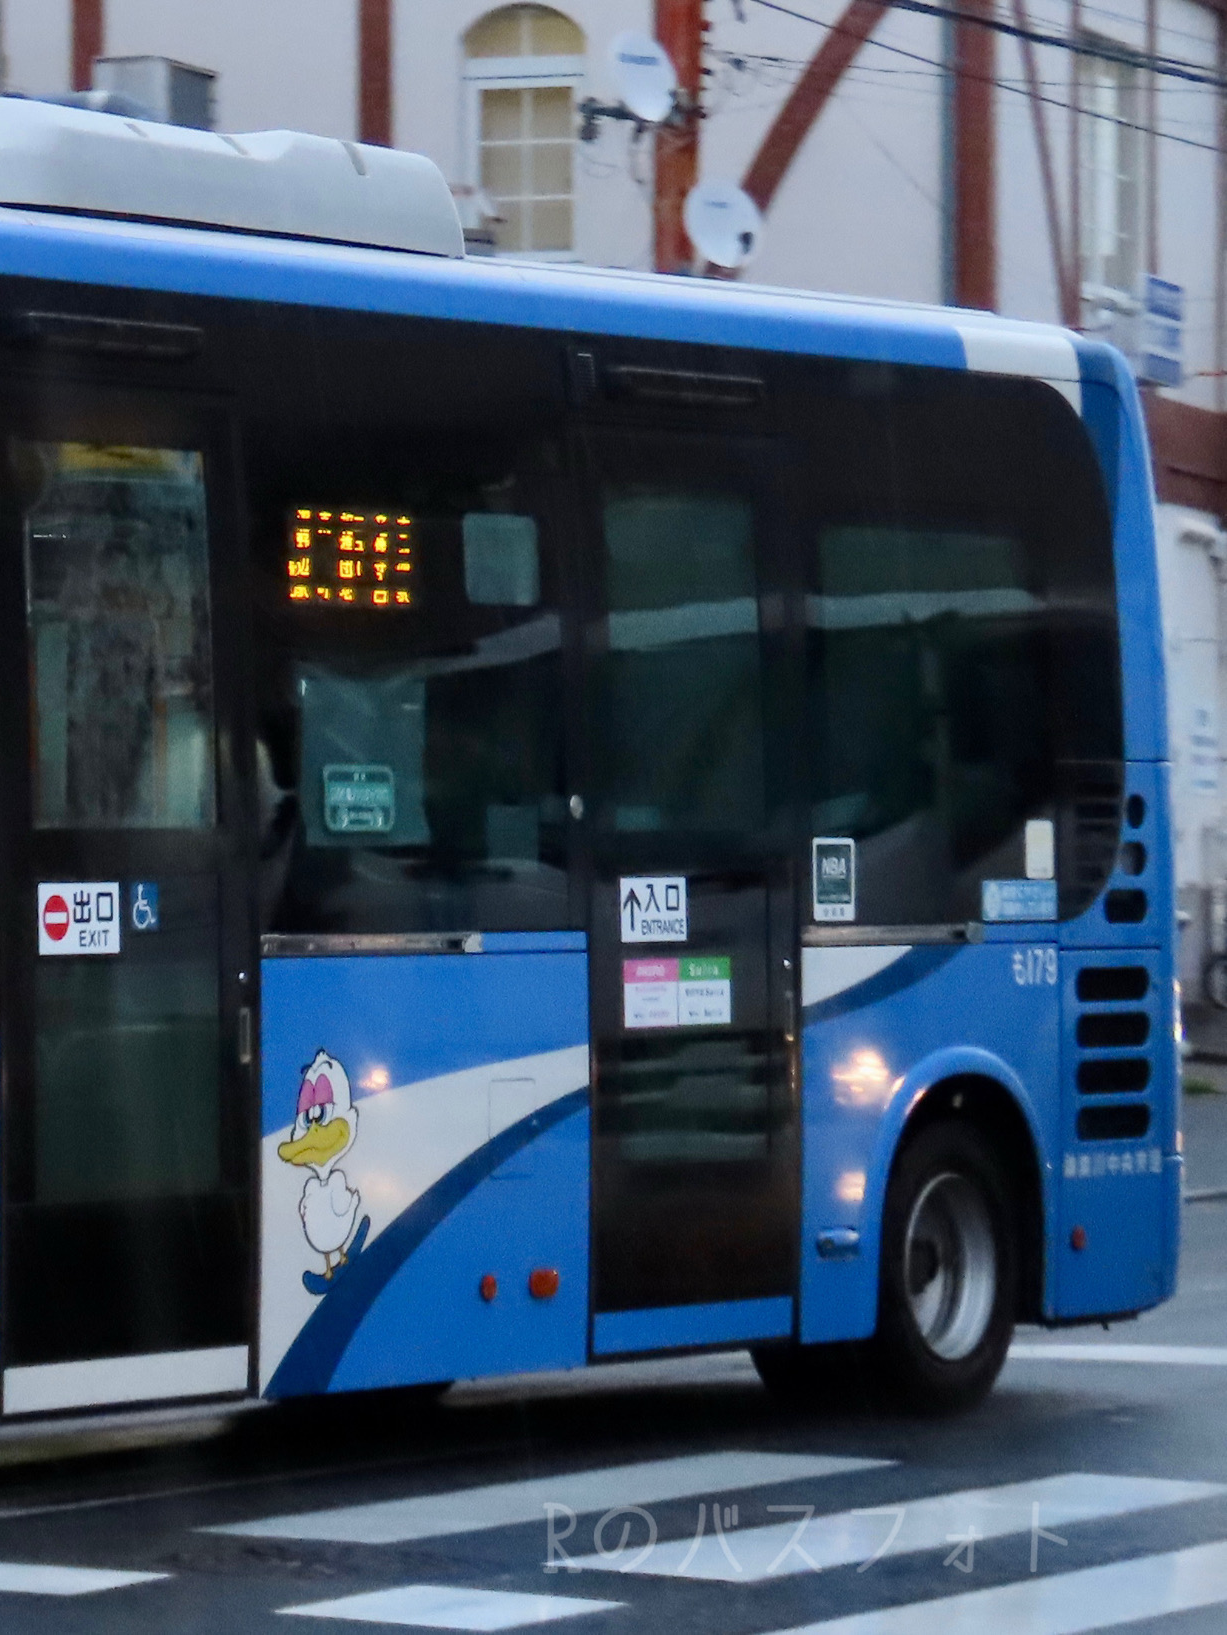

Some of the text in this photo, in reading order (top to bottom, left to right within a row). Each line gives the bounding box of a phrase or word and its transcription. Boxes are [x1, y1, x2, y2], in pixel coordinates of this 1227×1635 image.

[73, 889, 114, 924] 出口
[644, 883, 680, 913] 入口
[78, 930, 111, 948] EXIT
[640, 918, 686, 936] ENTRANCE
[1011, 948, 1058, 986] も179
